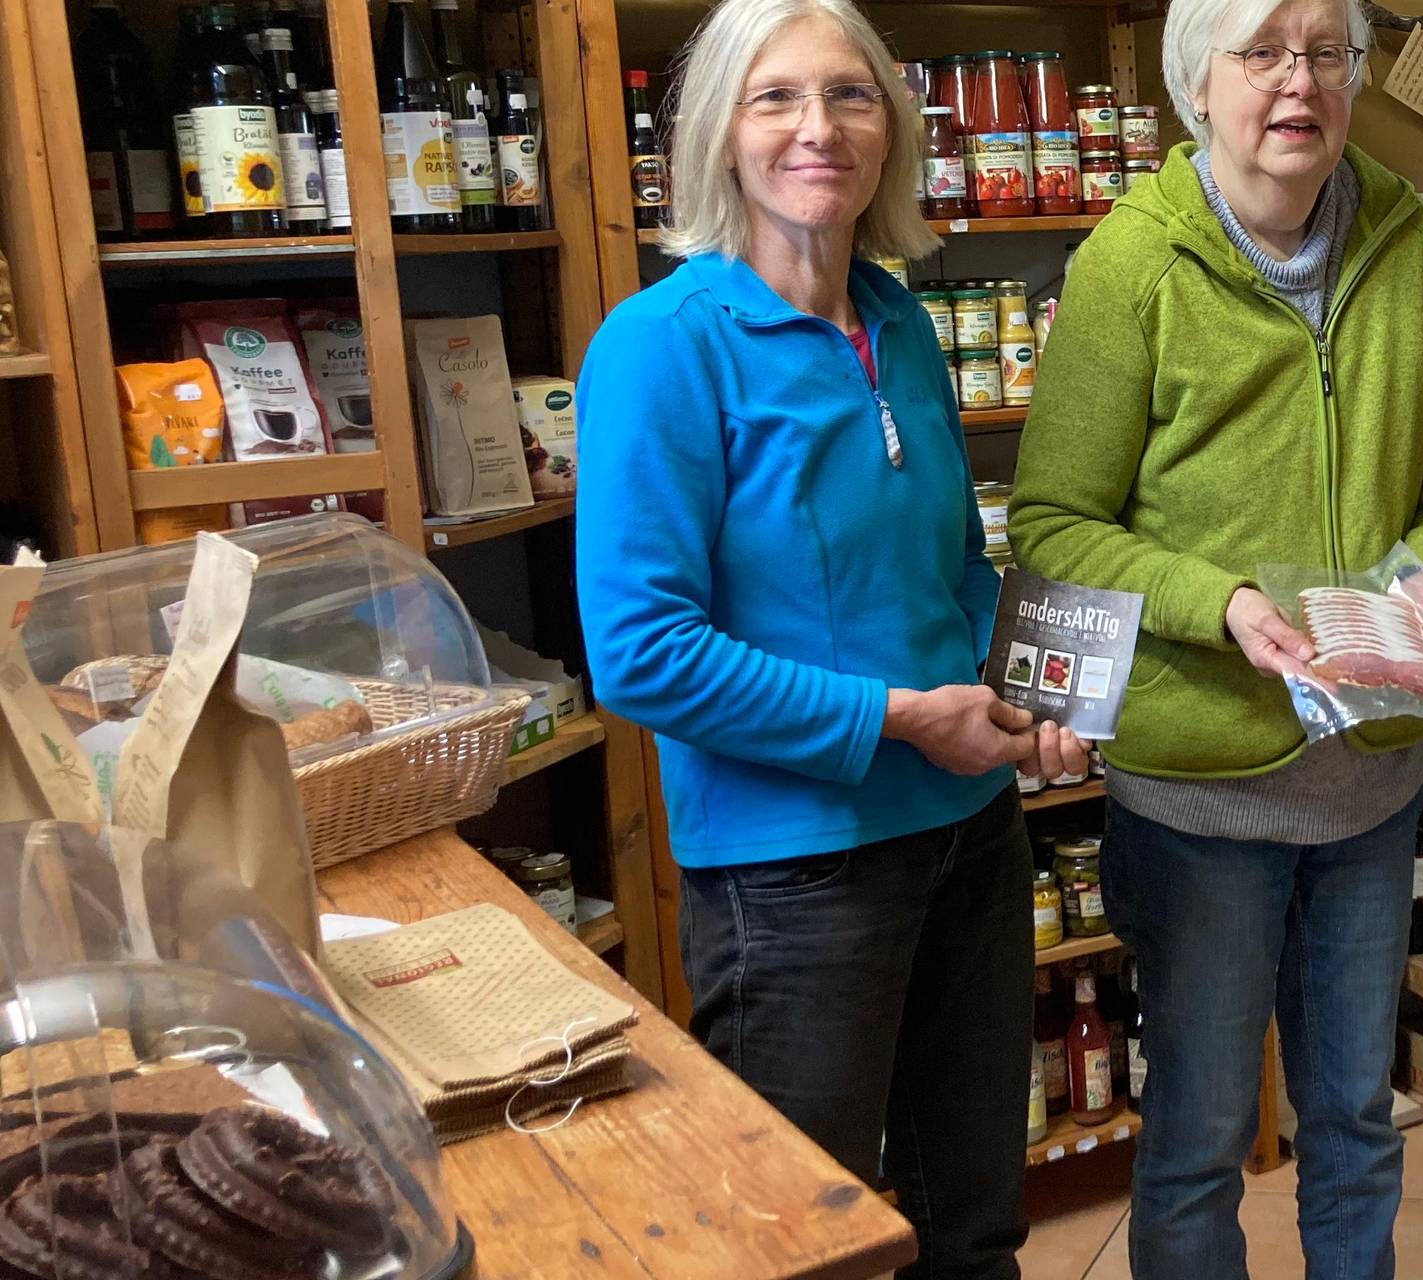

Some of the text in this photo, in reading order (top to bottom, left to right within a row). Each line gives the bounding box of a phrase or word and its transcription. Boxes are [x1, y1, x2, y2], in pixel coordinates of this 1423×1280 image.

[230, 366, 283, 379] Kaffee
[438, 348, 489, 373] Casolo
[1018, 597, 1120, 640] andersARTig
